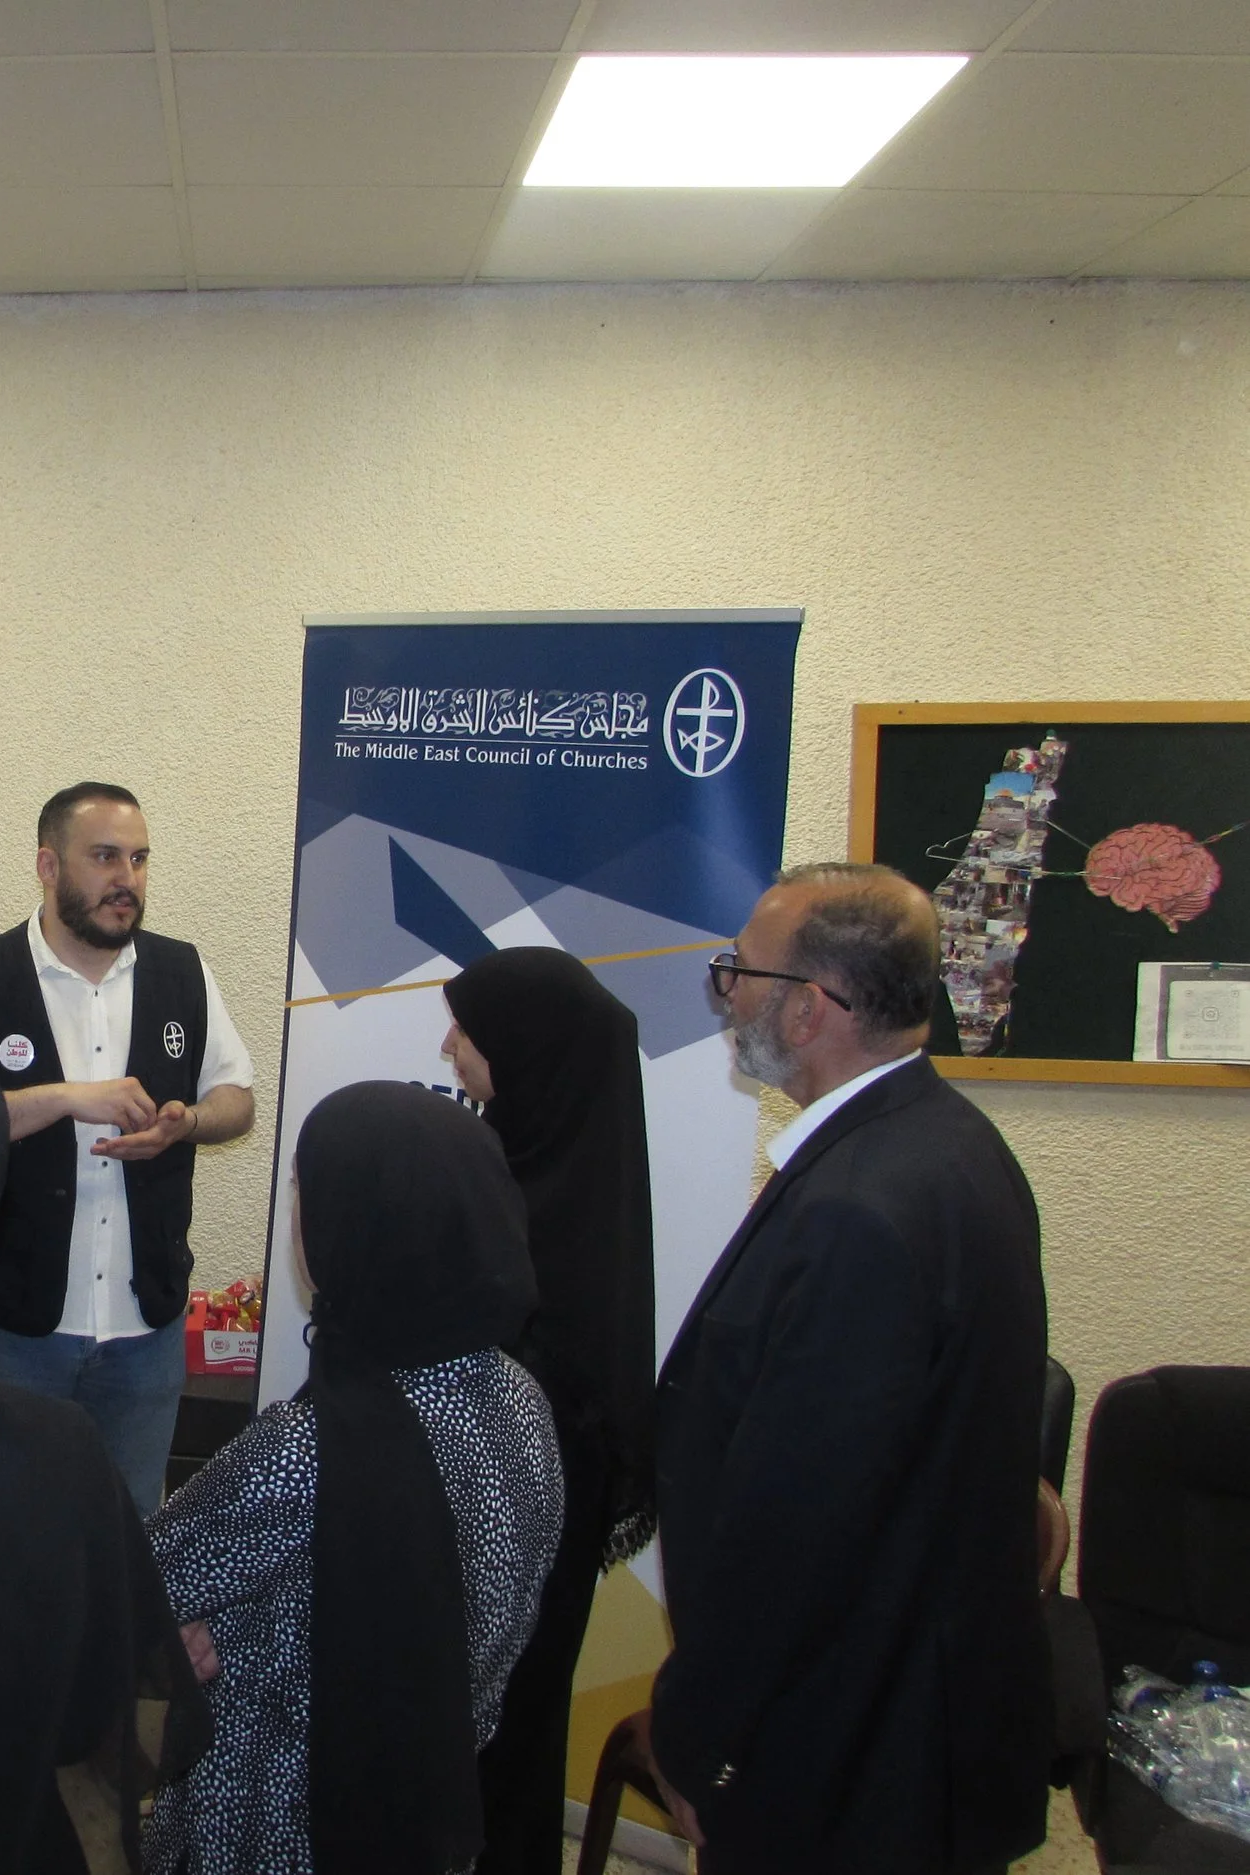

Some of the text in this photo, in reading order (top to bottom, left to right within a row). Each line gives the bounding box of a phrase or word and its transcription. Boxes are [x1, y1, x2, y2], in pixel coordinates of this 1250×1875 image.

[421, 687, 487, 735] الشرق
[488, 689, 575, 737] كنائس
[582, 691, 648, 739] مجلس
[334, 742, 648, 770] The Middle East Council of Churches
